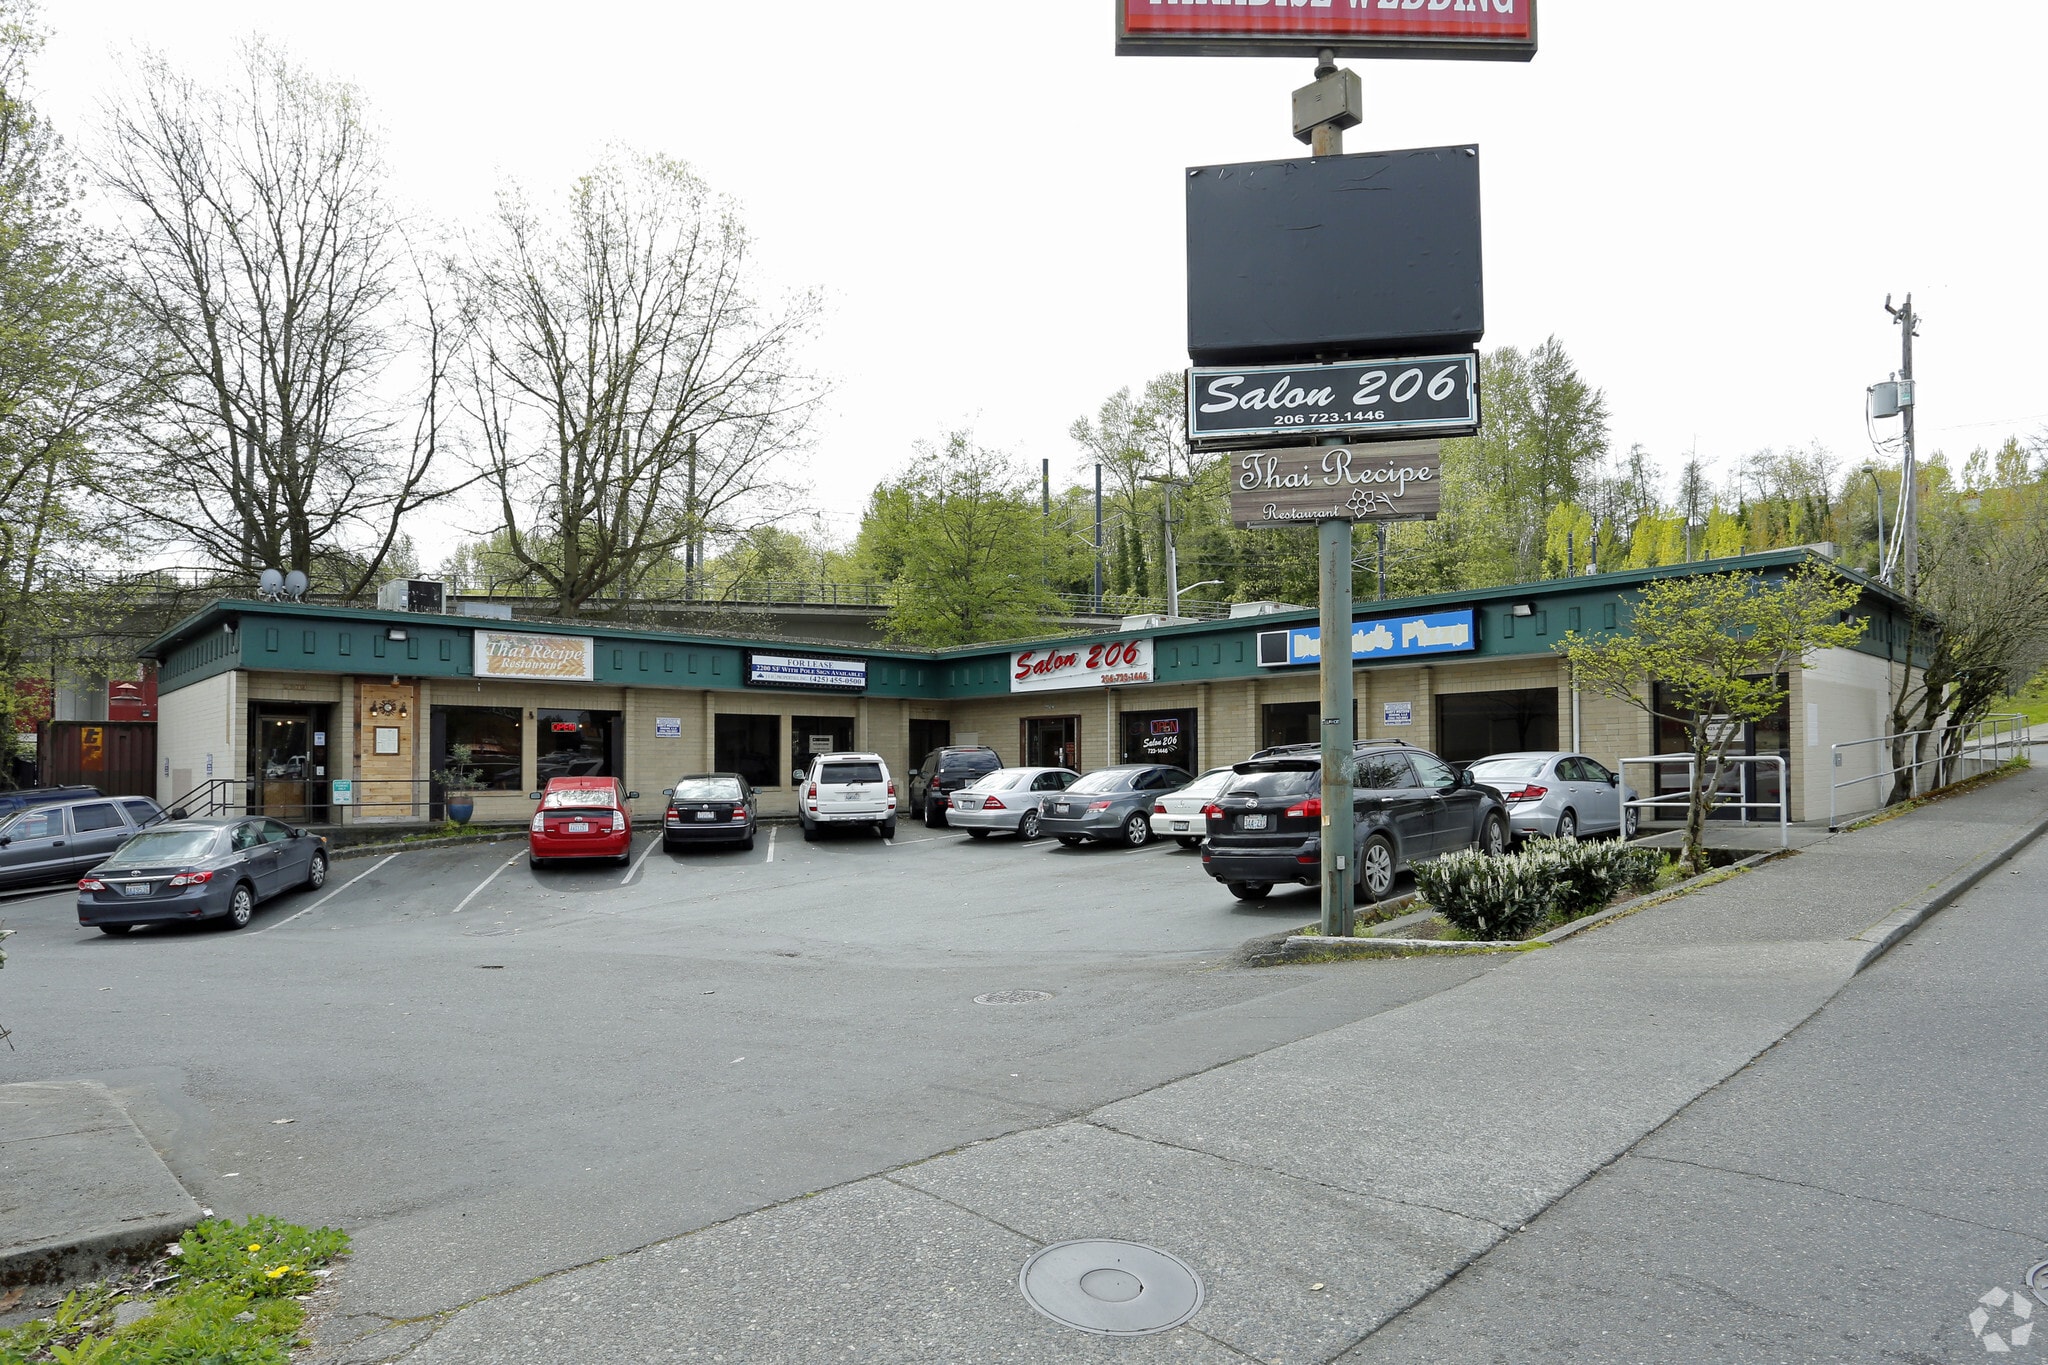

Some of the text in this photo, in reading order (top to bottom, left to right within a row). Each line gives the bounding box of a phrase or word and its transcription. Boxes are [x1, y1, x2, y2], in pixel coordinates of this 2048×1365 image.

[1199, 365, 1459, 413] Salon 206
[1273, 410, 1385, 425] 206 723.1446
[1239, 448, 1433, 498] Thai Recipe
[1262, 503, 1340, 520] Restaurant
[488, 642, 584, 664] Thai Recipe
[1014, 640, 1141, 680] Salon 206
[501, 658, 562, 670] Restaurant
[787, 659, 834, 669] FOR LEASE
[1143, 735, 1178, 748] Salon 206
